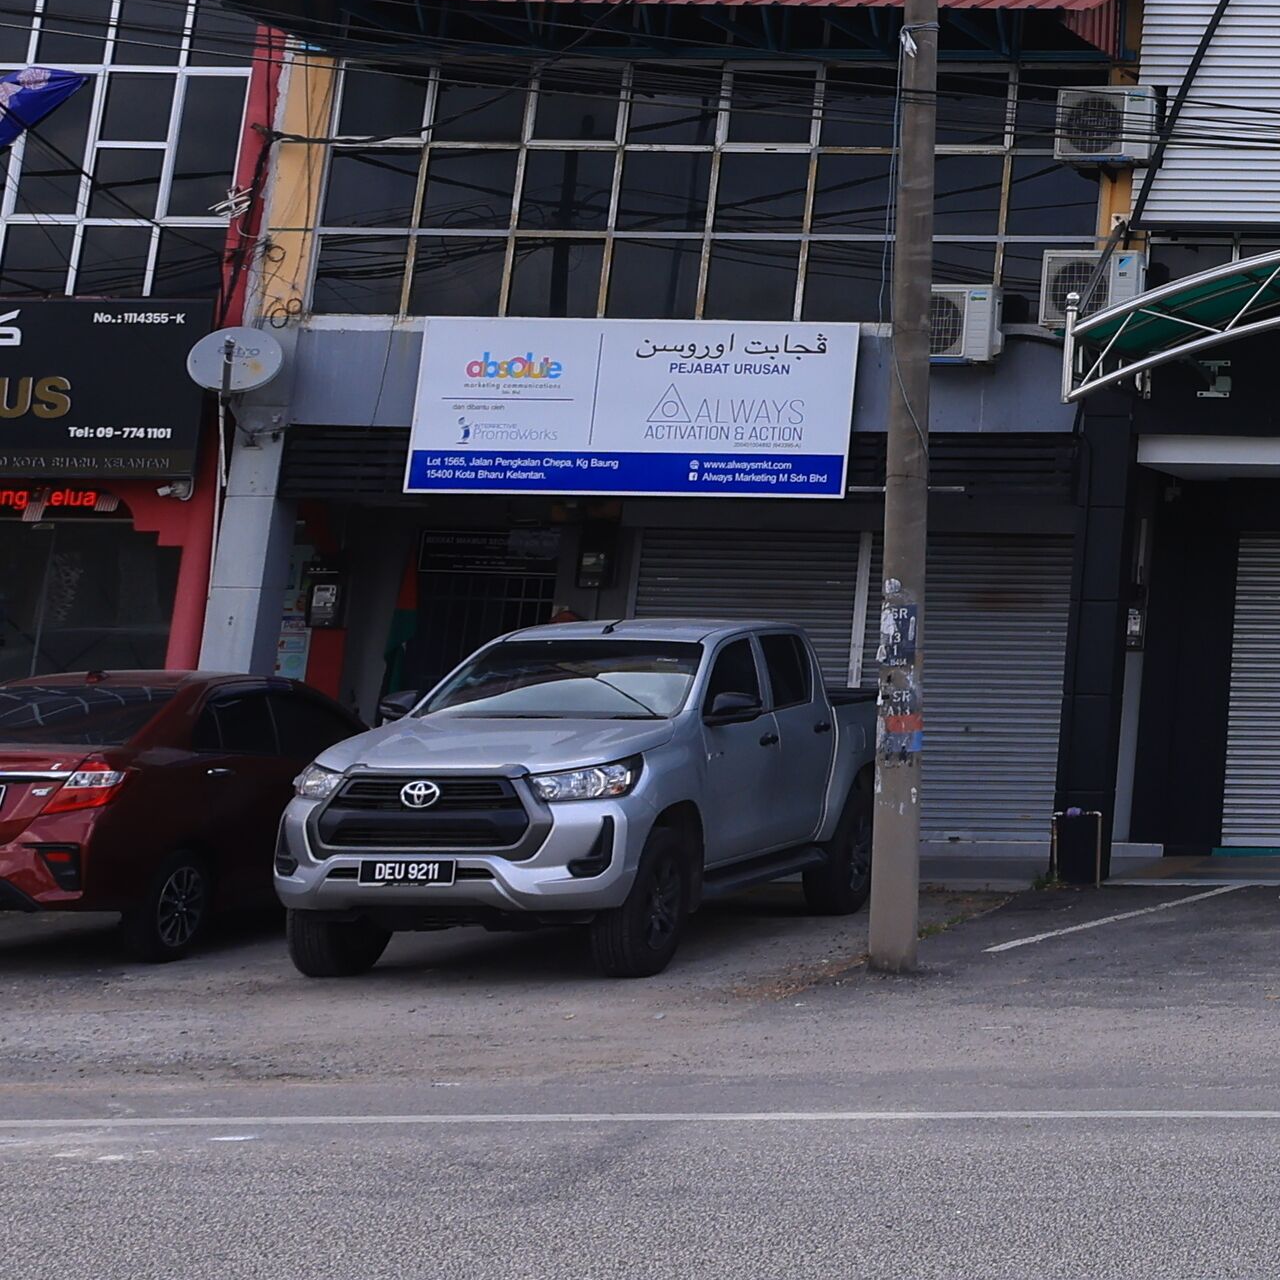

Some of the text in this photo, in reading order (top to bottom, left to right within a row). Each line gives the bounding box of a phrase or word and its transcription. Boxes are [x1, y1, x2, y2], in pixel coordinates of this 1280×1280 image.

[669, 362, 790, 376] PEJABAT URUSAN
[463, 382, 500, 390] marketing
[694, 398, 805, 425] ALWAYS
[68, 426, 94, 438] Tel:
[472, 428, 558, 441] PromoWorks
[644, 424, 803, 441] ACTIVATION & ACTION
[13, 456, 46, 468] KOTA
[426, 457, 441, 466] Lot
[443, 457, 467, 468] 1565,
[469, 457, 493, 467] Jalan
[495, 458, 541, 469] Pengkalan
[576, 458, 589, 470] Kg
[590, 458, 619, 470] Baung
[426, 469, 453, 478] 15400
[455, 470, 475, 479] Kota
[477, 470, 504, 479] Bharu
[702, 472, 827, 484] Always Marketing M Sdn Bhd
[374, 863, 439, 880] DEU 9211
